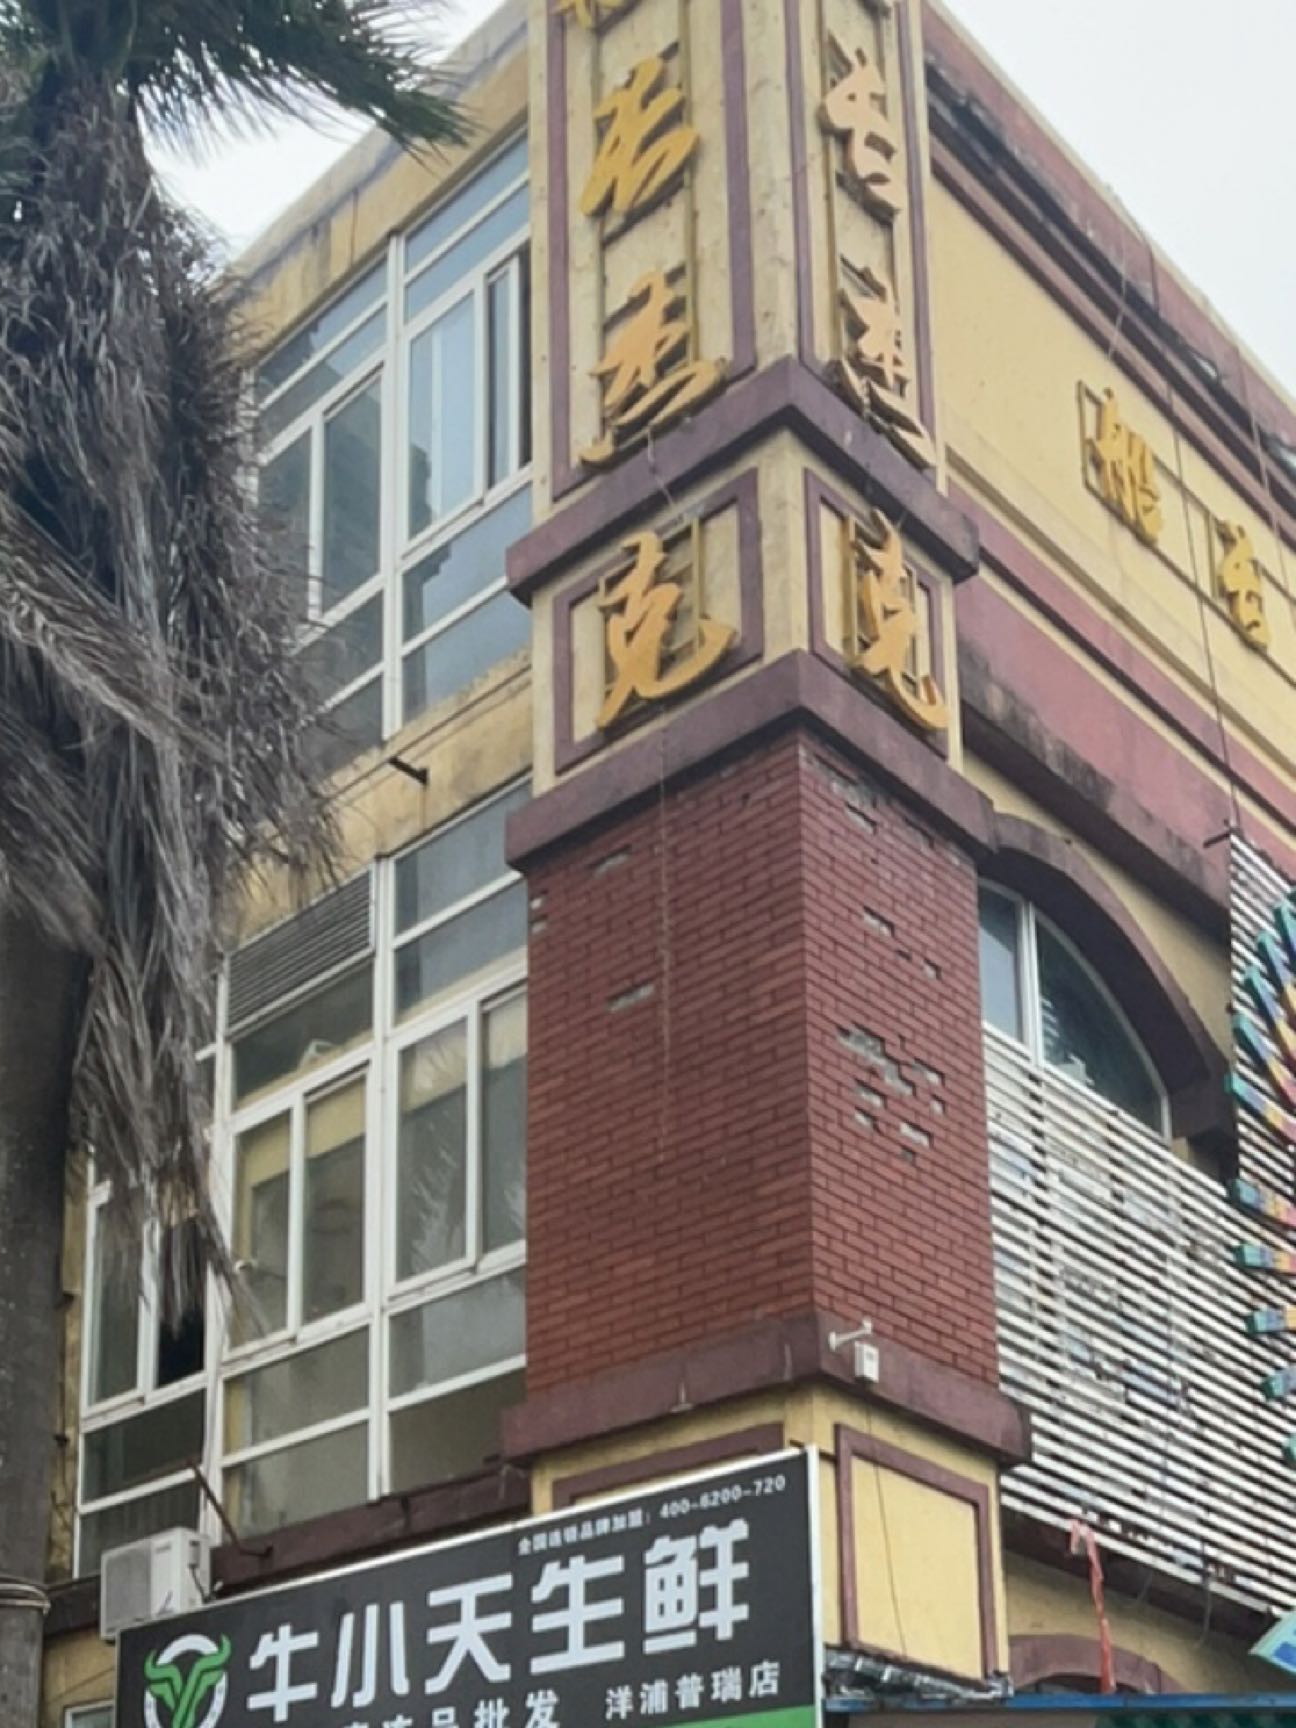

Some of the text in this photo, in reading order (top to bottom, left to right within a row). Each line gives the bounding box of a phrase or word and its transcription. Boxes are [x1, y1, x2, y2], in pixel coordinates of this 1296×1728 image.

[248, 1519, 751, 1723] 牛小天生鲜
[604, 1659, 781, 1720] 洋浦普瑞店
